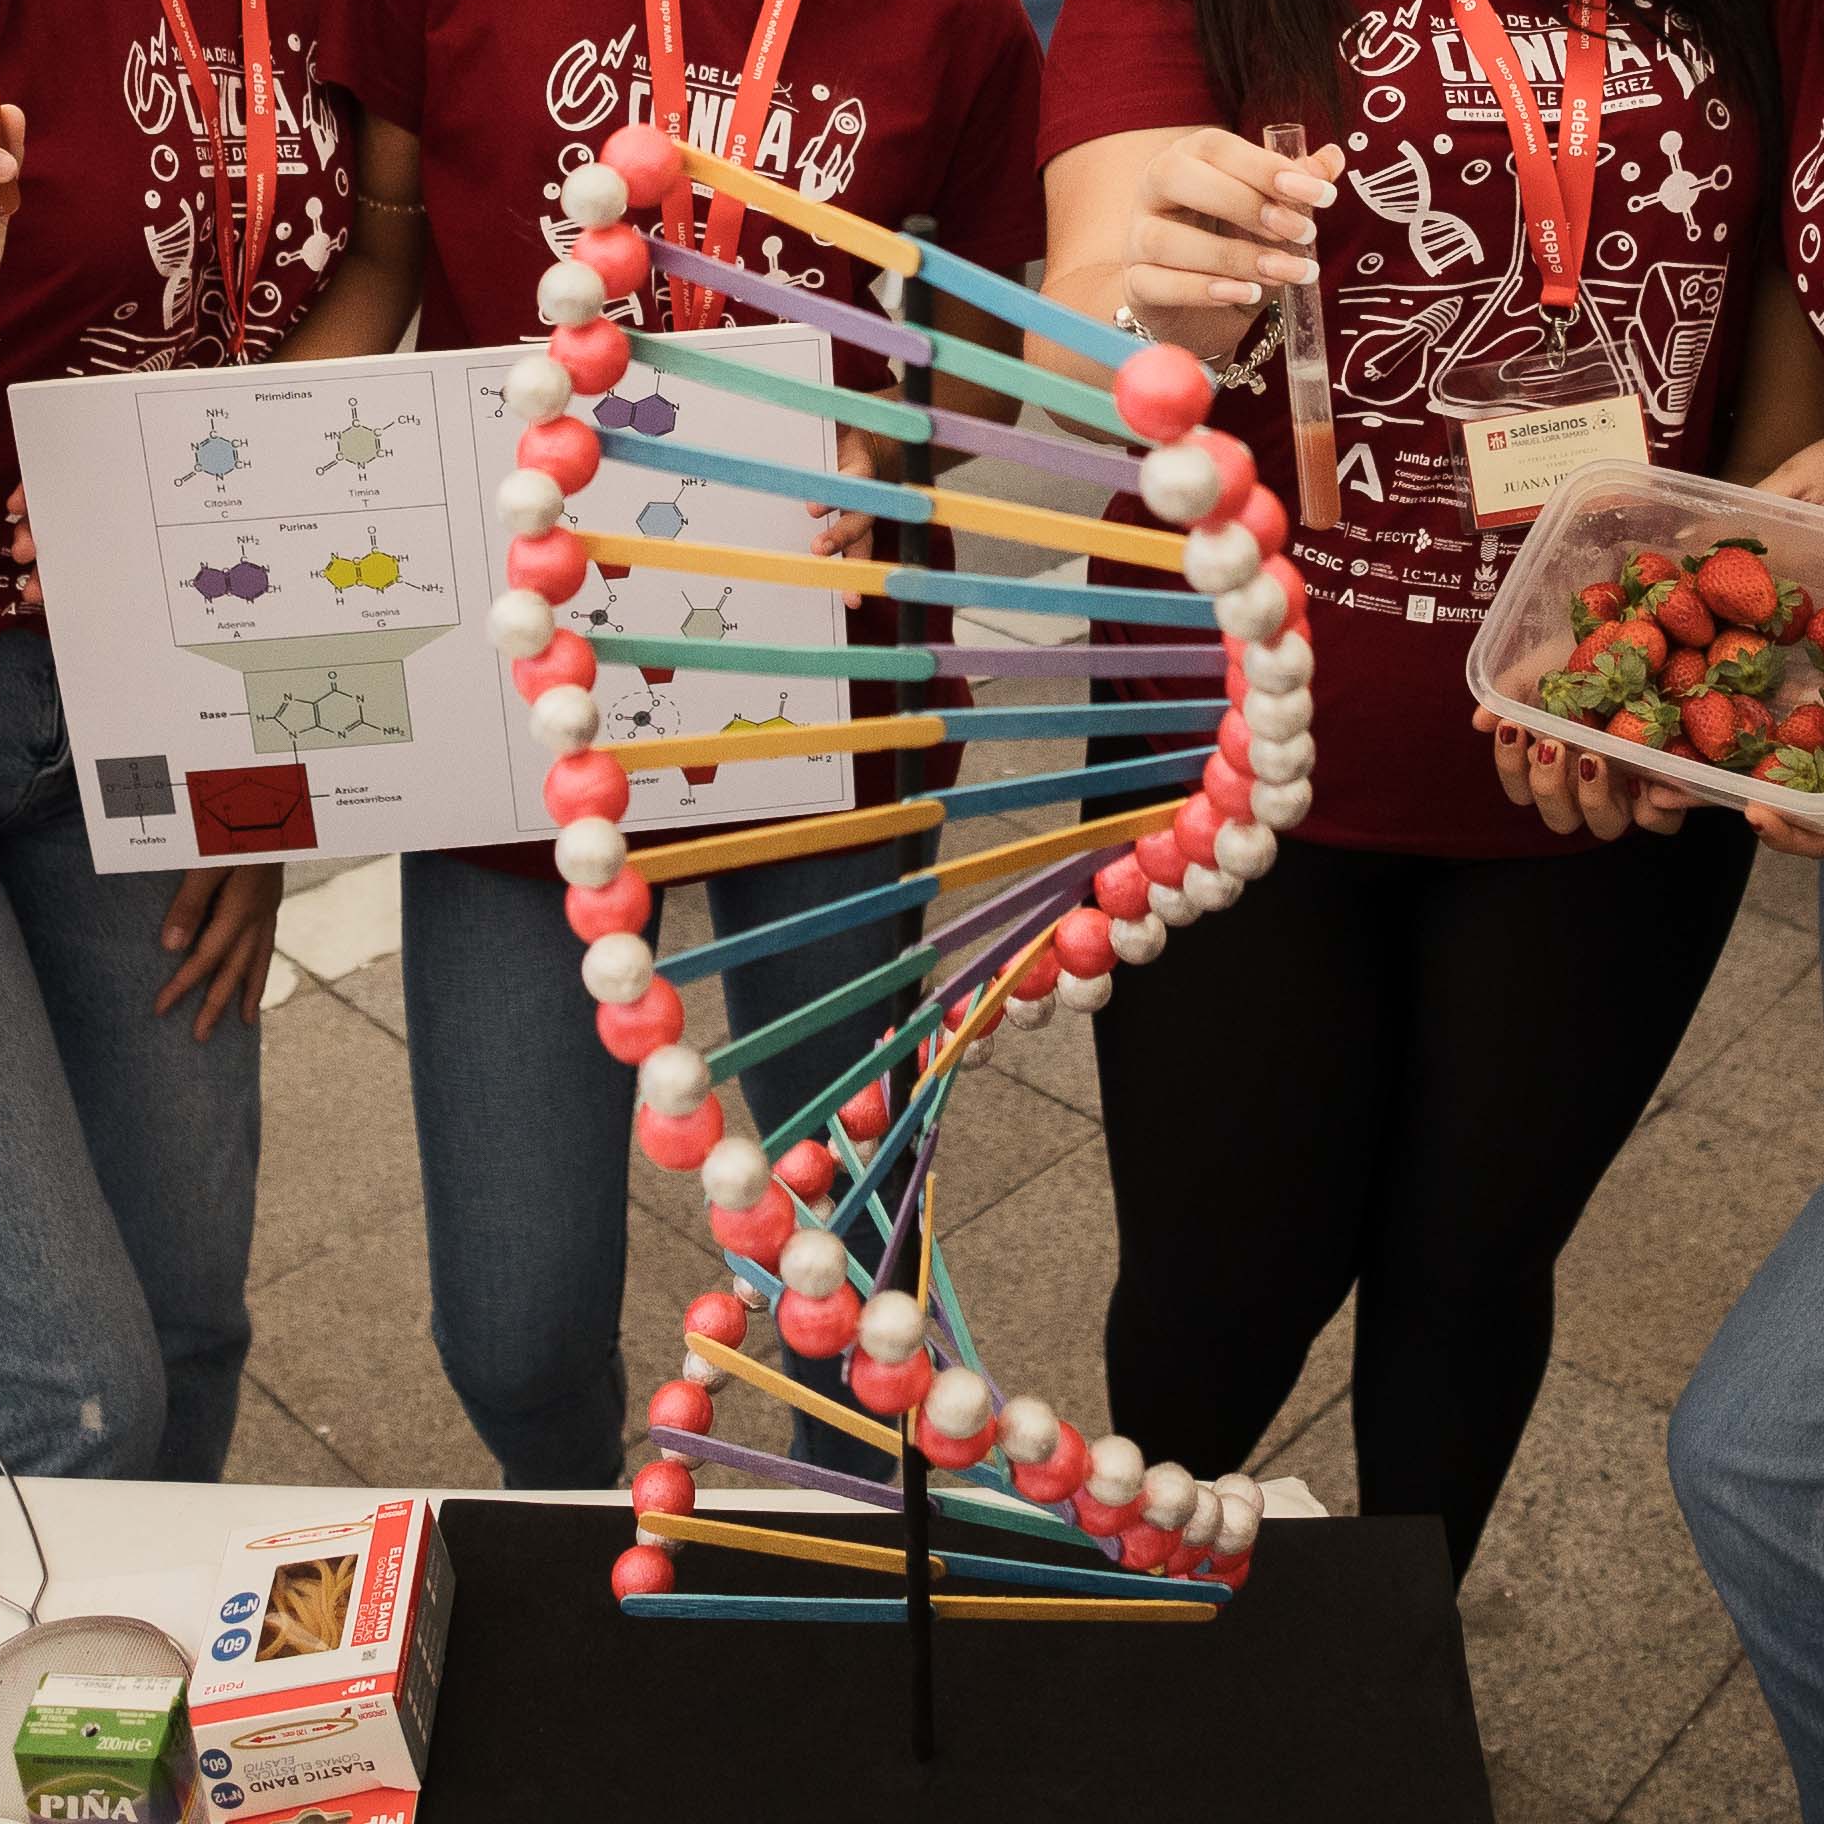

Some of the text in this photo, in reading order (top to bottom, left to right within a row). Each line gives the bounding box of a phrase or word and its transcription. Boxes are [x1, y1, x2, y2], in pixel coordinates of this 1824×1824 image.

[1507, 14, 1531, 28] DE
[1535, 16, 1560, 27] LA
[699, 66, 719, 82] DE
[723, 70, 742, 86] LA
[252, 62, 269, 115] edebé
[1446, 76, 1654, 105] EN LA EREZ
[1495, 56, 1537, 155] www.edebe.com
[1569, 98, 1589, 157] edebé
[1536, 219, 1563, 274] edebé
[255, 390, 313, 403] Pirimidinas
[1510, 417, 1587, 438] salesianos
[1561, 429, 1589, 439] TAMAYO
[1395, 451, 1449, 467] Junta de
[348, 487, 380, 497] Timina
[1503, 477, 1550, 494] JUANA
[204, 497, 243, 509] Citosina
[279, 522, 318, 532] Purinas
[1376, 531, 1417, 546] FECYT
[1304, 548, 1344, 572] CSIC
[362, 609, 400, 619] Guanina
[217, 620, 256, 630] Adenina
[199, 710, 227, 720] Base
[334, 784, 369, 795] Azúcar
[129, 836, 166, 845] Fosfato
[363, 1557, 387, 1643] GOMAS ELASTICAS
[374, 1547, 402, 1639] ELASTIC BAND
[354, 1604, 369, 1643] ELASTICI
[217, 1636, 246, 1652] 60g
[202, 1756, 227, 1771] 60g
[243, 1755, 295, 1771] ELASTICI
[245, 1752, 361, 1781] GOMAS ELASTICAS
[249, 1761, 376, 1794] ELASTIC BAND
[39, 1788, 138, 1823] PIÑA
